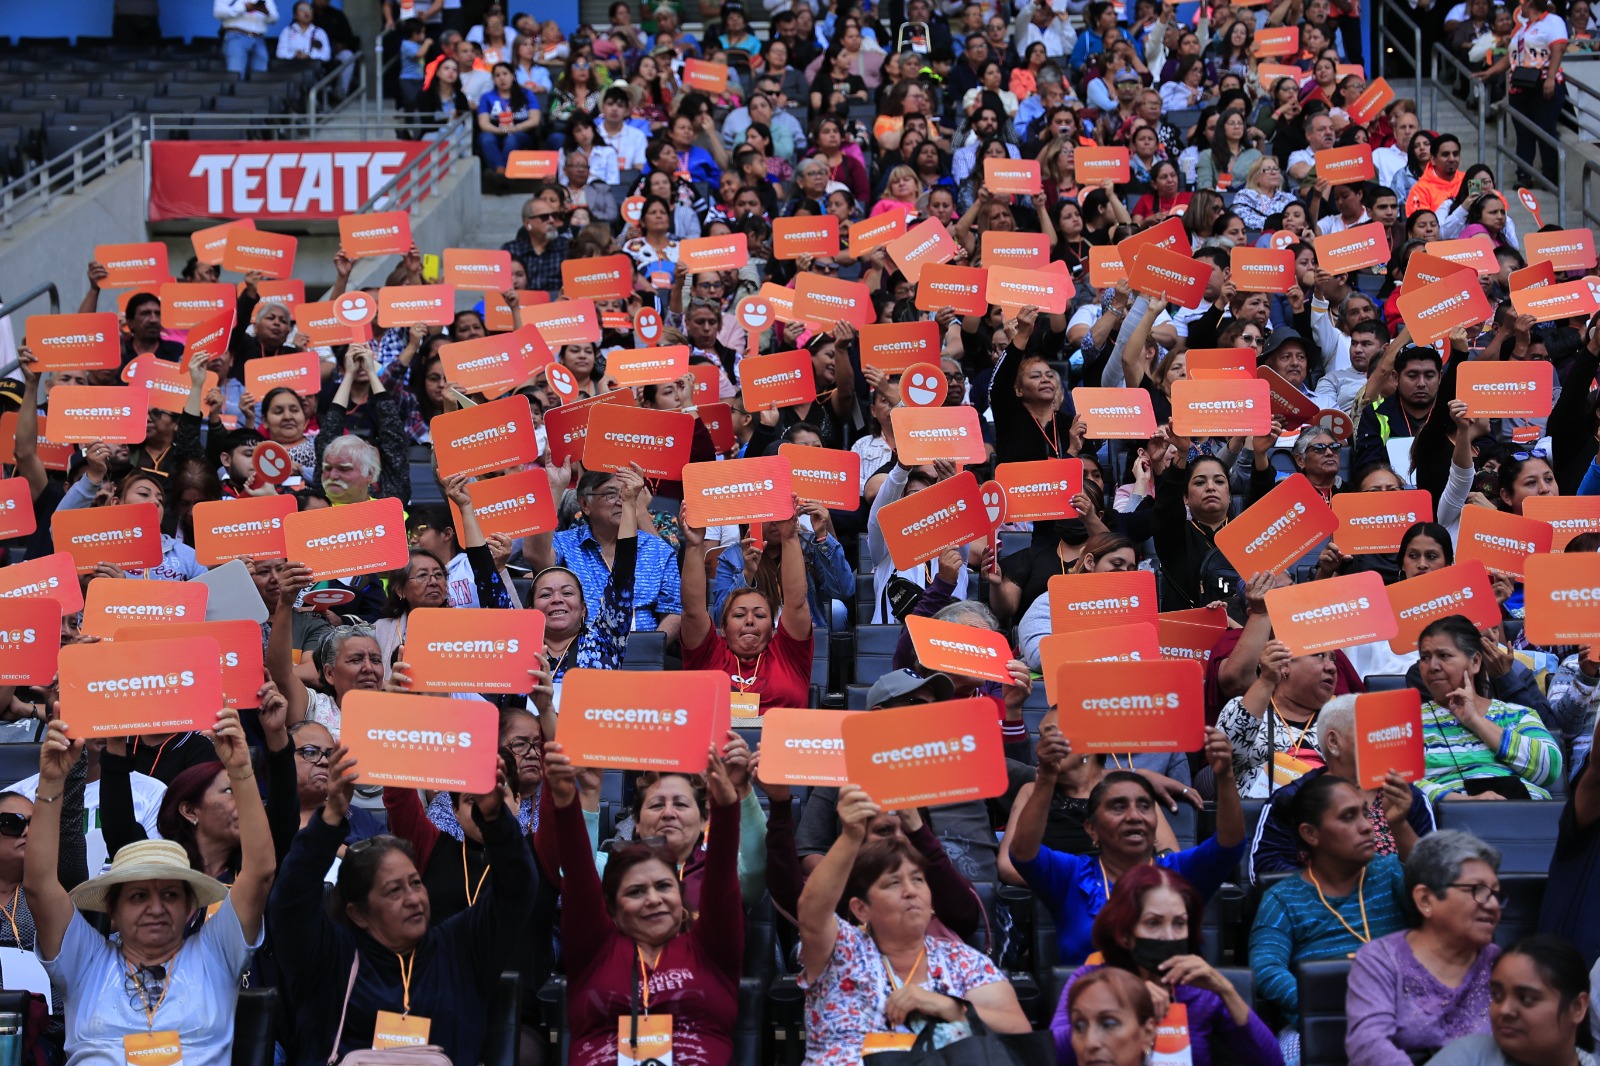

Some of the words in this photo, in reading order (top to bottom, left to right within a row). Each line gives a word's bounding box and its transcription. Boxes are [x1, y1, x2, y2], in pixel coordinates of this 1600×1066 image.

[189, 152, 407, 214] TECATE
[905, 234, 941, 261] crecemos
[993, 247, 1039, 256] crecemos
[1328, 238, 1376, 256] crecemos
[1537, 243, 1584, 254] crecemos
[1146, 264, 1196, 286] crecemos
[1242, 264, 1285, 273] crecemos
[930, 283, 979, 294] crecemos
[1000, 282, 1054, 294] crecemos
[807, 292, 856, 307] crecemos
[1417, 290, 1470, 319] crecemos
[1527, 292, 1580, 307] crecemos
[42, 332, 104, 345] crecemos
[191, 327, 224, 350] crecemos
[873, 339, 927, 351] crecemos
[457, 352, 510, 370] crecemos
[620, 358, 675, 370] crecemos
[753, 369, 802, 386] crecemos
[1472, 381, 1537, 391] crecemos
[64, 406, 131, 416] crecemos
[1089, 405, 1141, 415] crecemos
[1188, 399, 1254, 410] crecemos
[451, 421, 517, 448] crecemos
[604, 432, 675, 448] crecemos
[909, 426, 967, 438] crecemos
[462, 435, 508, 451] GUADALUPE
[614, 442, 663, 451] GUADALUPE
[792, 469, 847, 482] crecemos
[702, 479, 774, 496] crecemos
[1009, 480, 1068, 494] crecemos
[713, 491, 763, 500] GUADALUPE
[901, 499, 967, 536] crecemos
[913, 513, 960, 538] GUADALUPE
[1349, 512, 1417, 526] crecemos
[211, 517, 281, 535] crecemos
[222, 529, 271, 539] GUADALUPE
[1245, 502, 1306, 554] crecemos
[71, 527, 143, 544] crecemos
[306, 525, 386, 548] crecemos
[1258, 517, 1301, 553] GUADALUPE
[83, 538, 132, 549] GUADALUPE
[319, 538, 374, 553] GUADALUPE
[1474, 533, 1536, 554] crecemos
[105, 605, 186, 617] crecemos
[1068, 595, 1140, 611] crecemos
[1291, 597, 1370, 622] crecemos
[1399, 587, 1474, 619] crecemos
[1079, 608, 1129, 616] GUADALUPE
[1305, 610, 1360, 626] GUADALUPE
[1413, 601, 1465, 622] GUADALUPE
[427, 639, 519, 653] crecemos
[929, 638, 998, 657] crecemos
[87, 670, 195, 693] crecemos
[104, 688, 179, 699] GUADALUPE
[1082, 693, 1179, 710] crecemos
[584, 709, 688, 726] crecemos
[1097, 709, 1164, 717] GUADALUPE
[598, 723, 670, 731] GUADALUPE
[1368, 722, 1413, 743] crecemos
[367, 729, 472, 748] crecemos
[382, 742, 455, 753] GUADALUPE
[872, 735, 977, 764] crecemos
[889, 754, 961, 771] GUADALUPE
